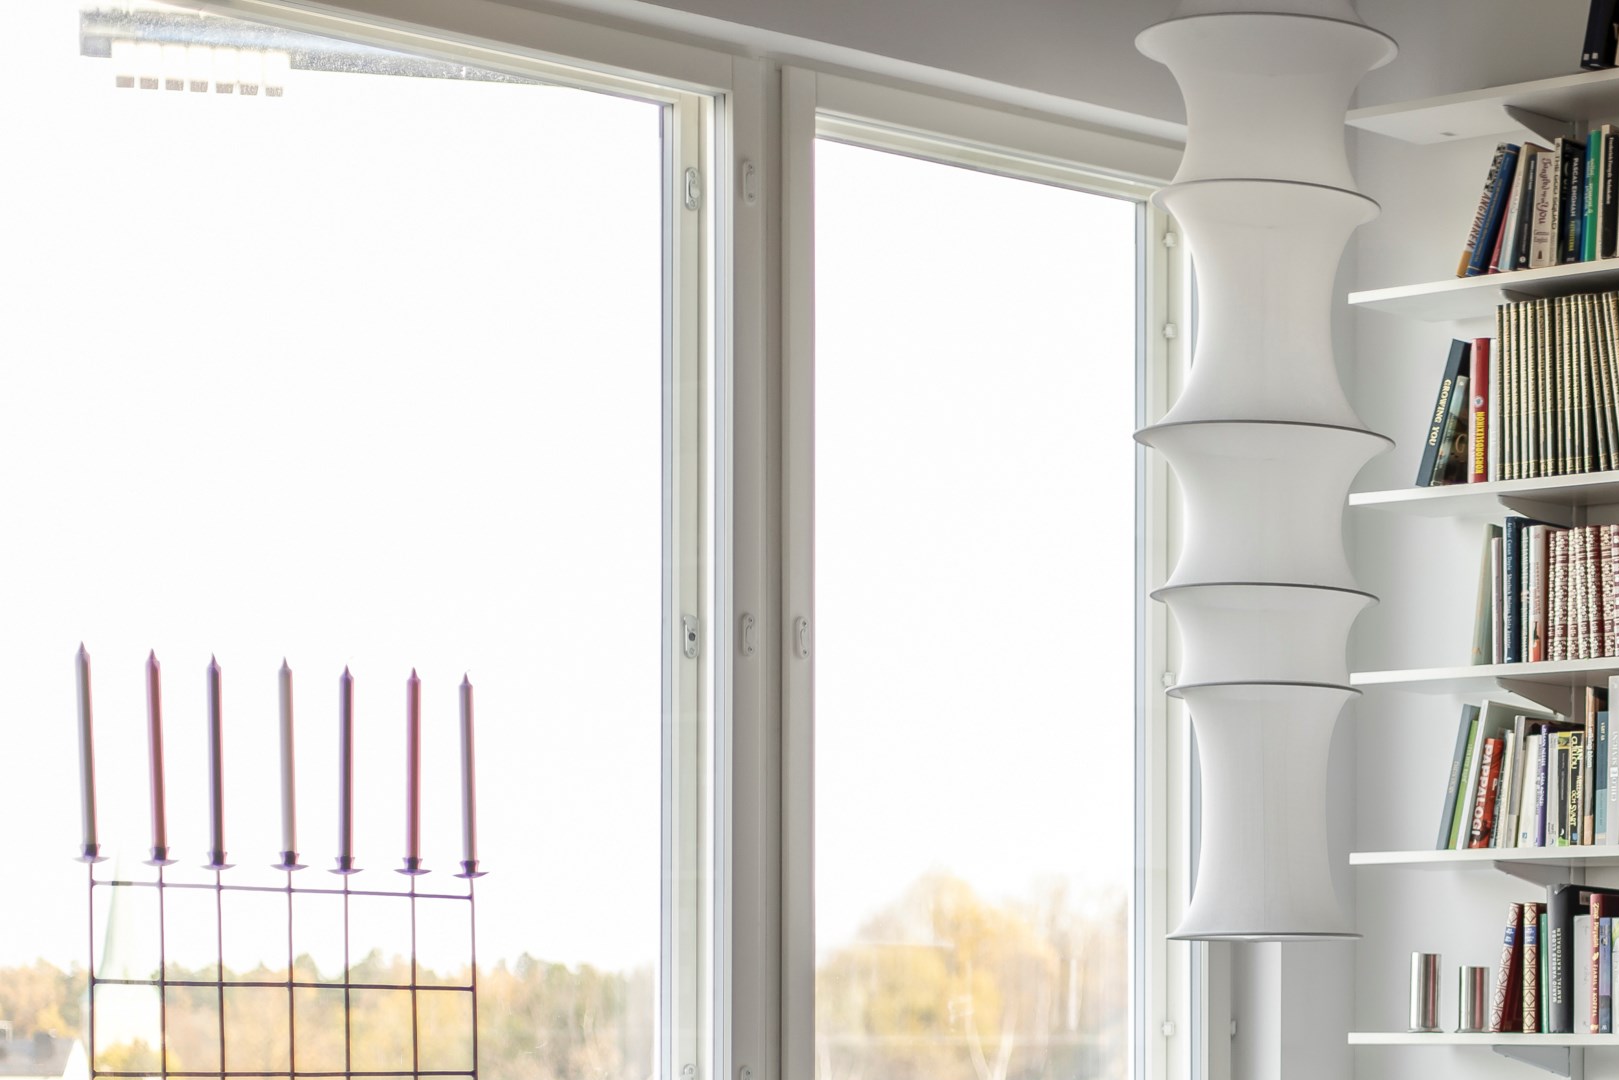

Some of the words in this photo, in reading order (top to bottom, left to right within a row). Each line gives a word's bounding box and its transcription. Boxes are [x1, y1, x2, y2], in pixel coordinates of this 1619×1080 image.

[1571, 157, 1580, 184] PASCAL
[1570, 186, 1579, 217] ENGMAN
[1466, 192, 1491, 248] ANGIVAREN
[1434, 379, 1452, 423] GROWING
[1428, 425, 1441, 447] YOU
[1586, 728, 1594, 750] wiking
[1471, 743, 1493, 836] PAPPALOGI
